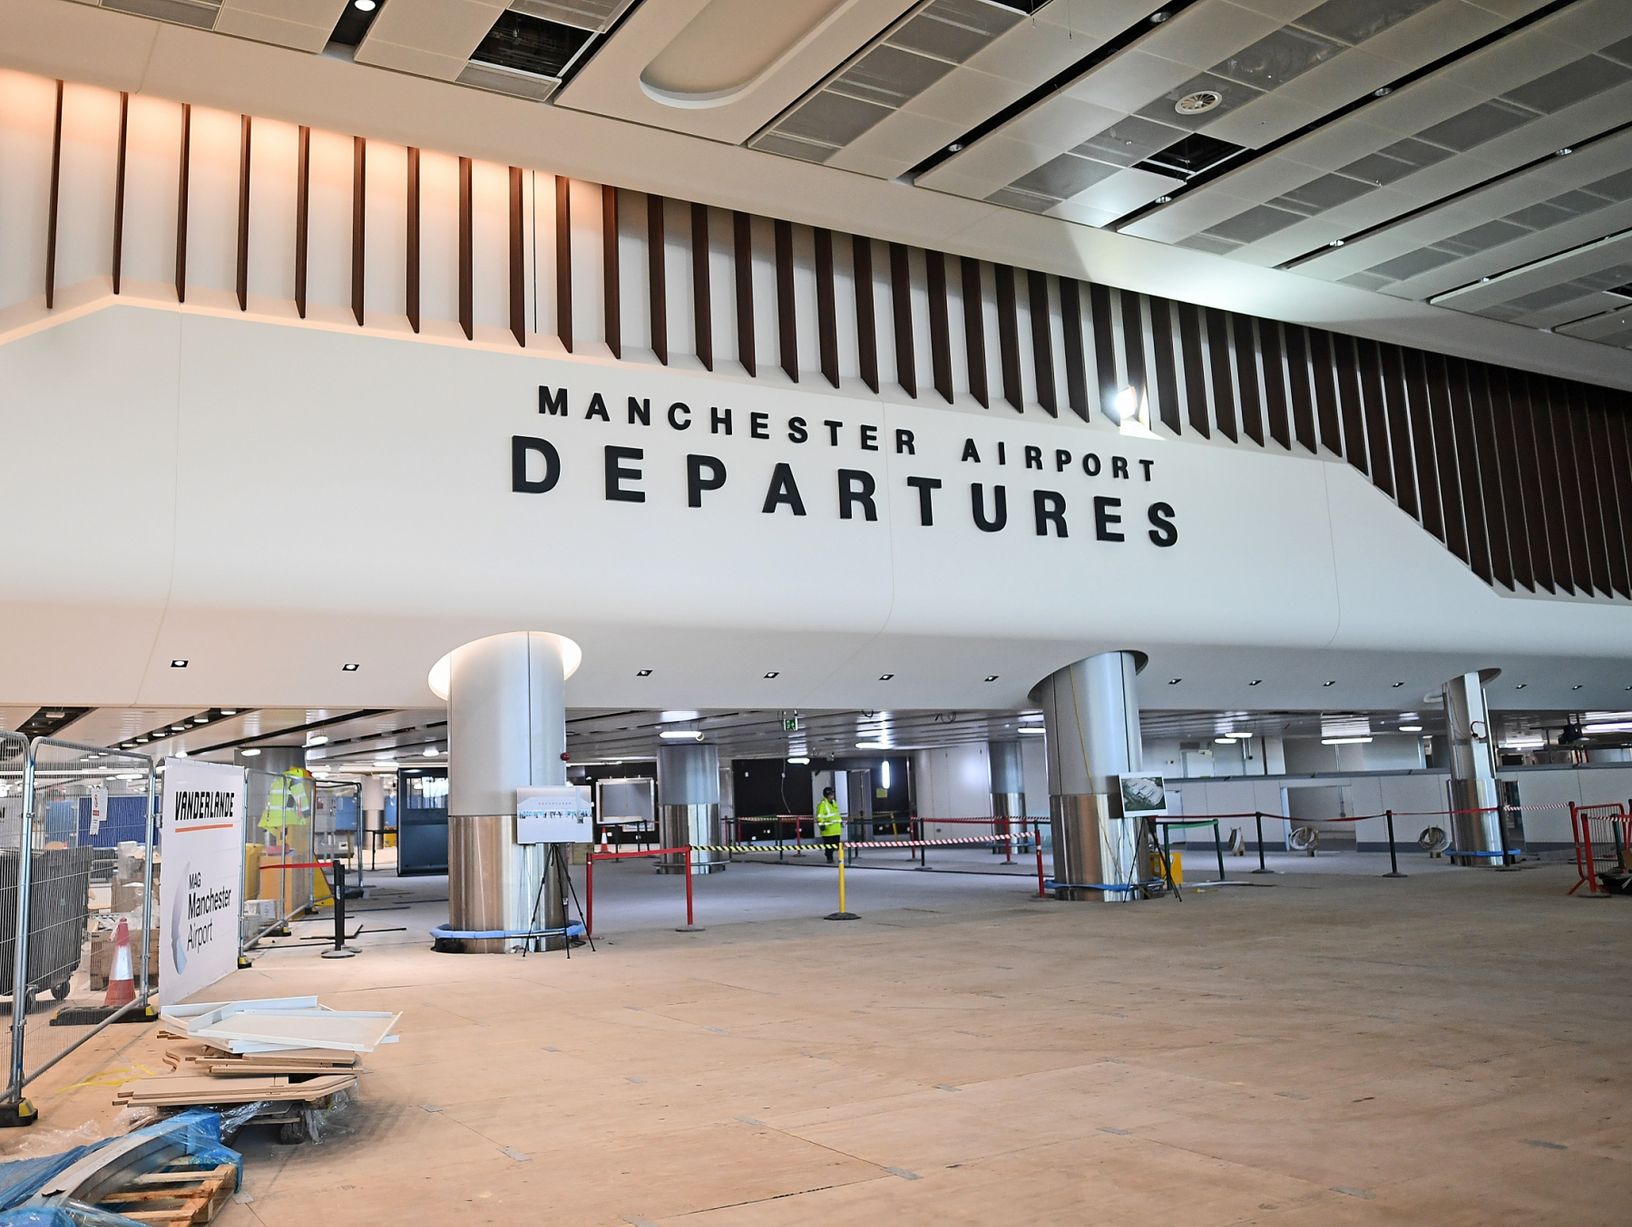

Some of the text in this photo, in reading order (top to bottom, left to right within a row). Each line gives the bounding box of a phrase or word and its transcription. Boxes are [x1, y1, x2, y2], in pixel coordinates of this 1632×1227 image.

[538, 385, 1155, 482] MANCHESTER AIRPORT
[511, 435, 1178, 548] DEPARTURES
[174, 790, 235, 822] VANDERLANDE
[189, 872, 202, 889] MAG
[187, 887, 232, 920] Manchester
[187, 918, 213, 953] Airport
